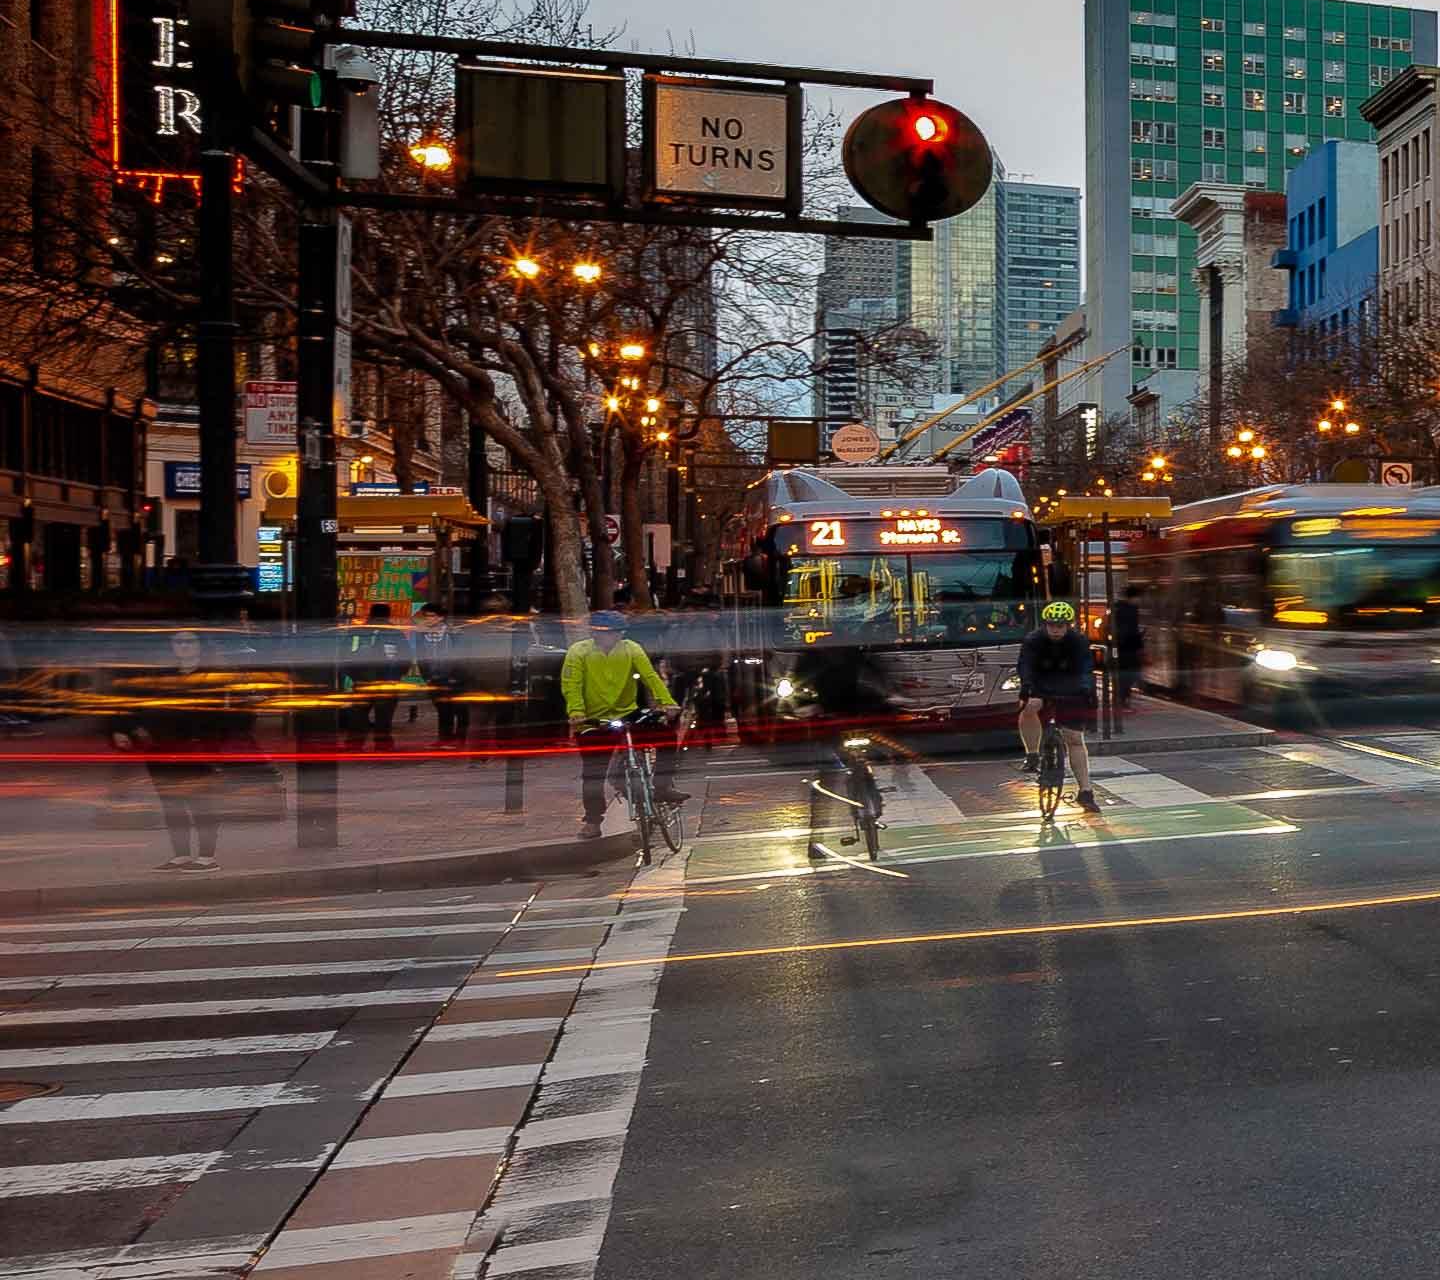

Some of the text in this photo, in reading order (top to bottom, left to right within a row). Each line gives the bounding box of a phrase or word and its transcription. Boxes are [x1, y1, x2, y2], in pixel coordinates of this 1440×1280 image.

[701, 116, 743, 140] NO
[667, 142, 775, 172] TURNS
[810, 520, 845, 546] 21
